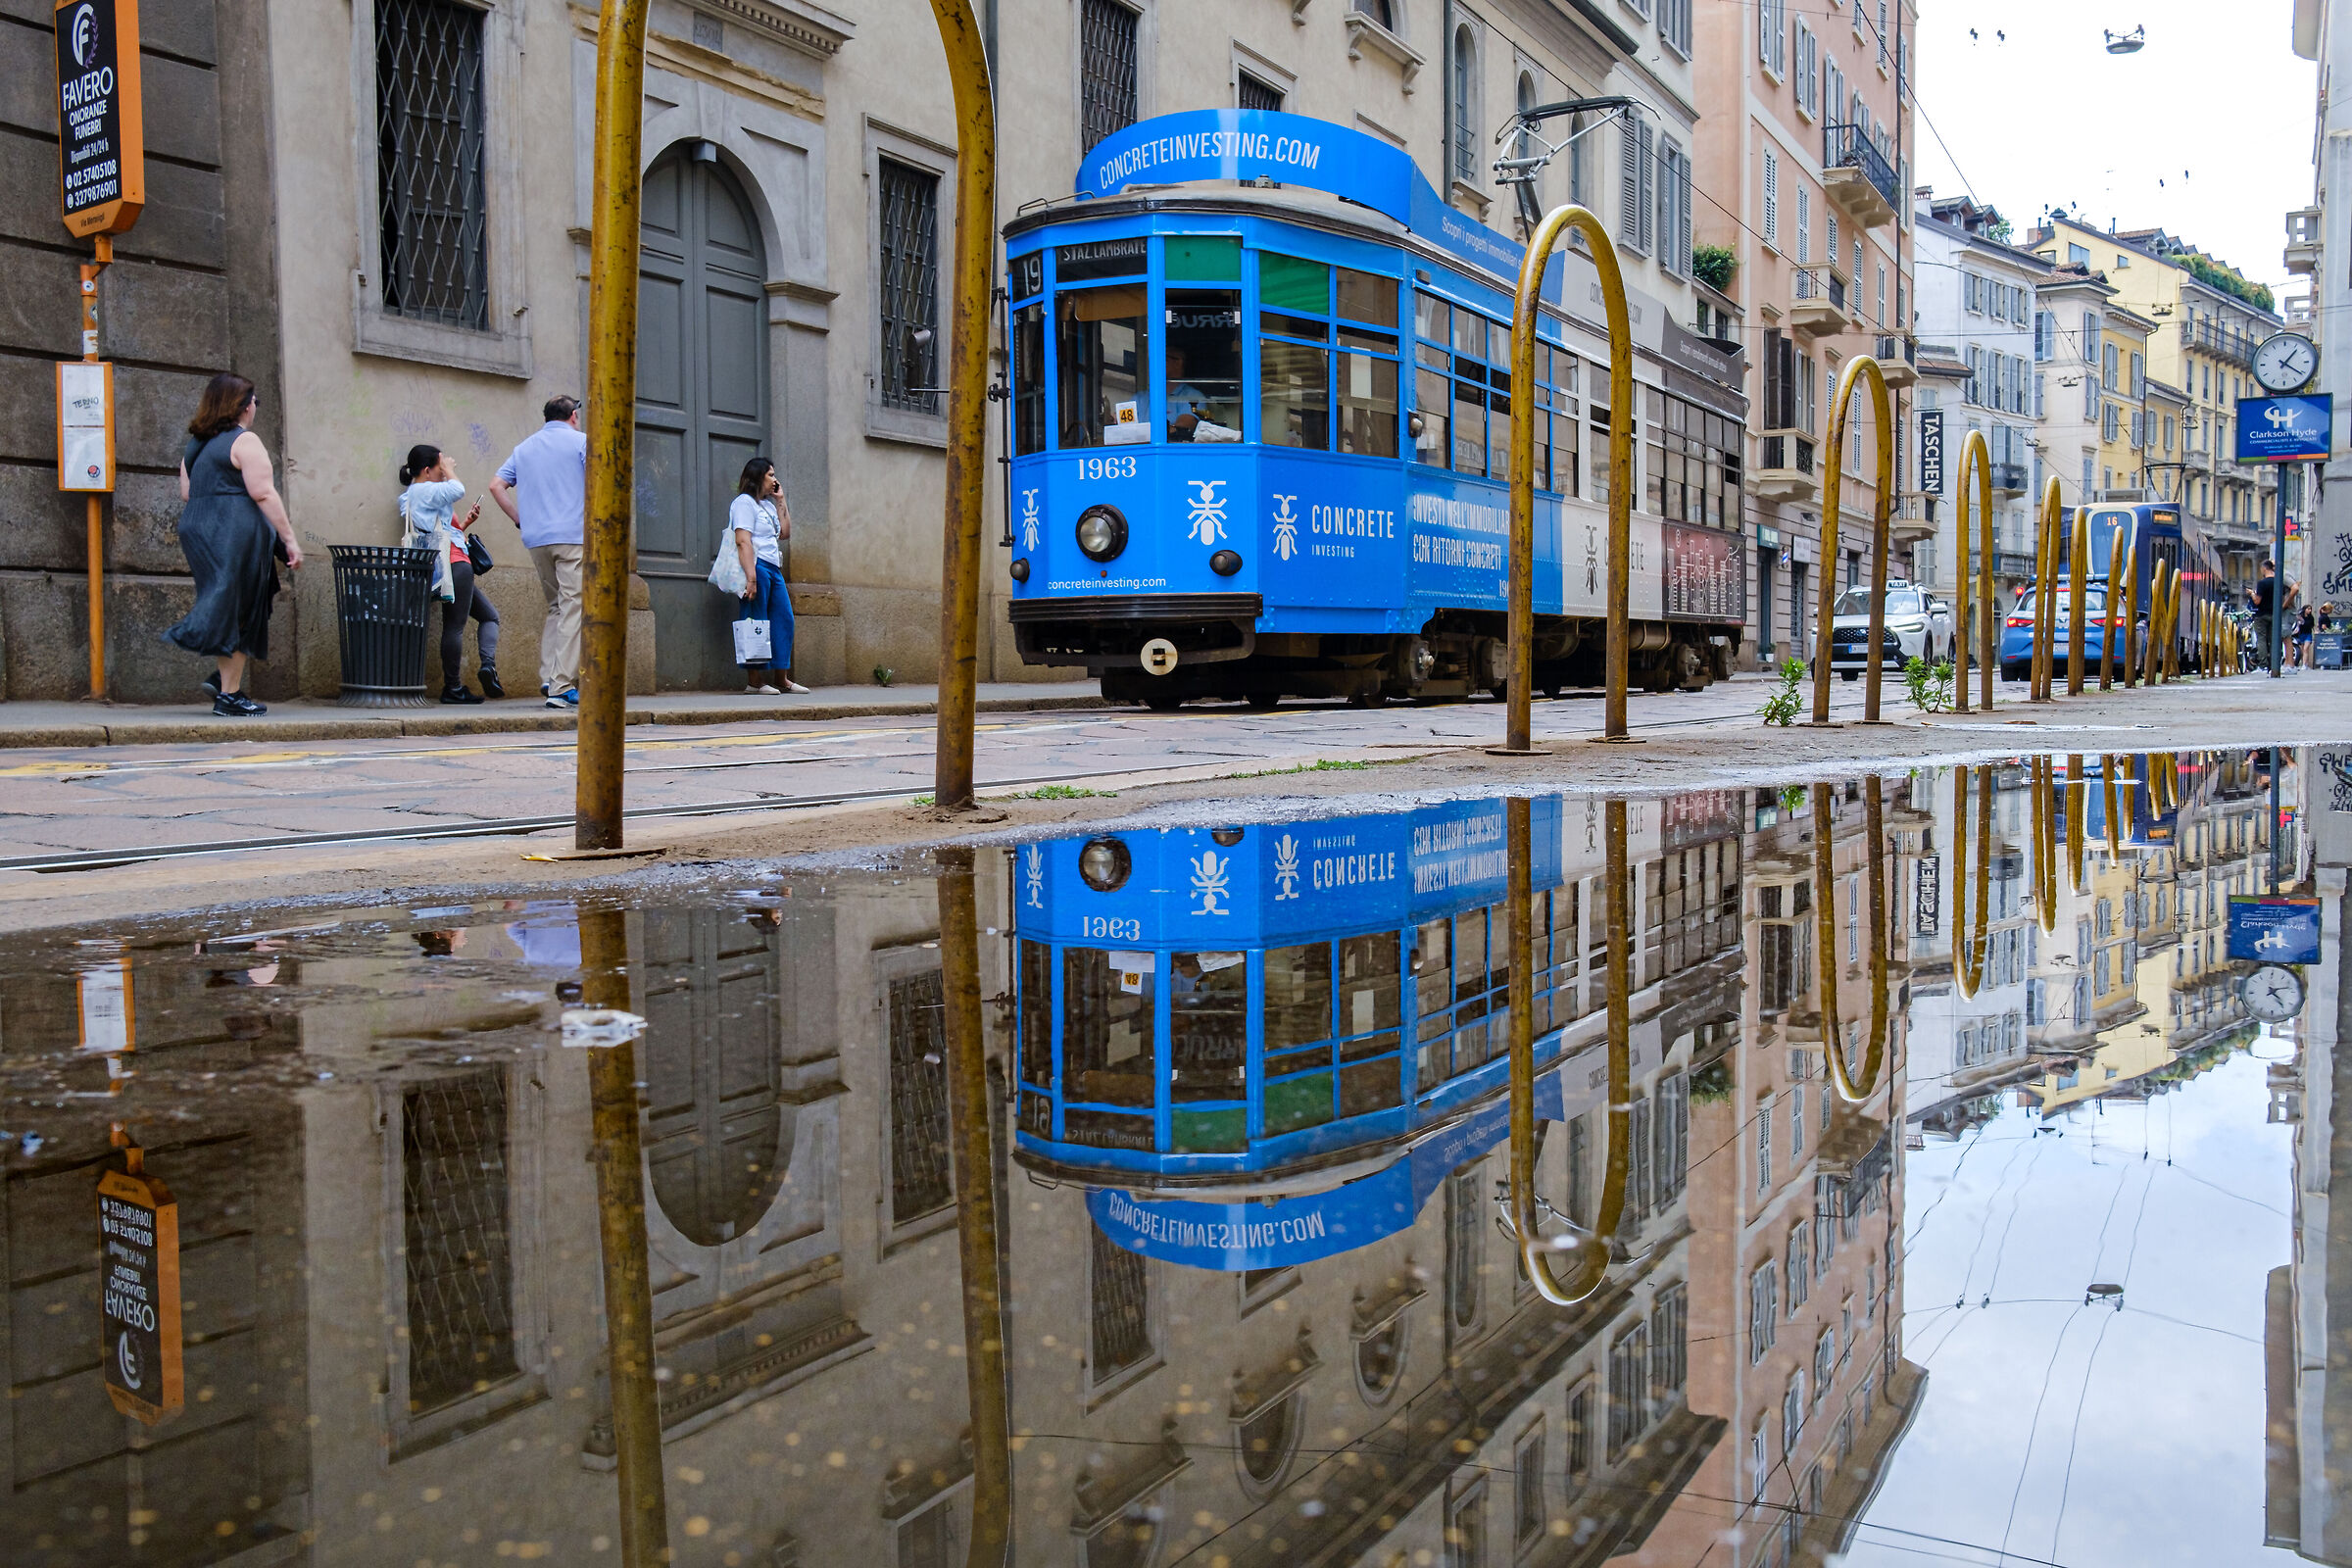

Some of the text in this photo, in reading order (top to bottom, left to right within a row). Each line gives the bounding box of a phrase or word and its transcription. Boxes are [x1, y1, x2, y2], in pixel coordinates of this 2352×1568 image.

[63, 66, 113, 112] FAVERO
[69, 99, 107, 126] ONORANZE
[74, 118, 102, 141] FUNEBRI
[73, 159, 117, 187] 02 57405108
[1100, 131, 1321, 191] CONCRETEINVESTING.COM
[74, 179, 118, 207] 3279876901
[1442, 216, 1462, 241] Scopri
[1466, 231, 1488, 253] progetti
[1023, 256, 1041, 297] 19
[1120, 409, 1134, 422] 48
[2250, 428, 2317, 439] Clarkson Hyde
[1924, 415, 1939, 492] TASCHEN
[1078, 456, 1137, 480] 1963
[1311, 504, 1395, 539] CONCRETE
[1414, 494, 1510, 536] INVESTI NELL'IMMOBILIAR
[2107, 516, 2118, 526] 16
[1311, 544, 1355, 558] INVESTING
[1413, 534, 1501, 571] CON RITORNI CONCRETI
[1048, 576, 1166, 590] concreteinvesting.com
